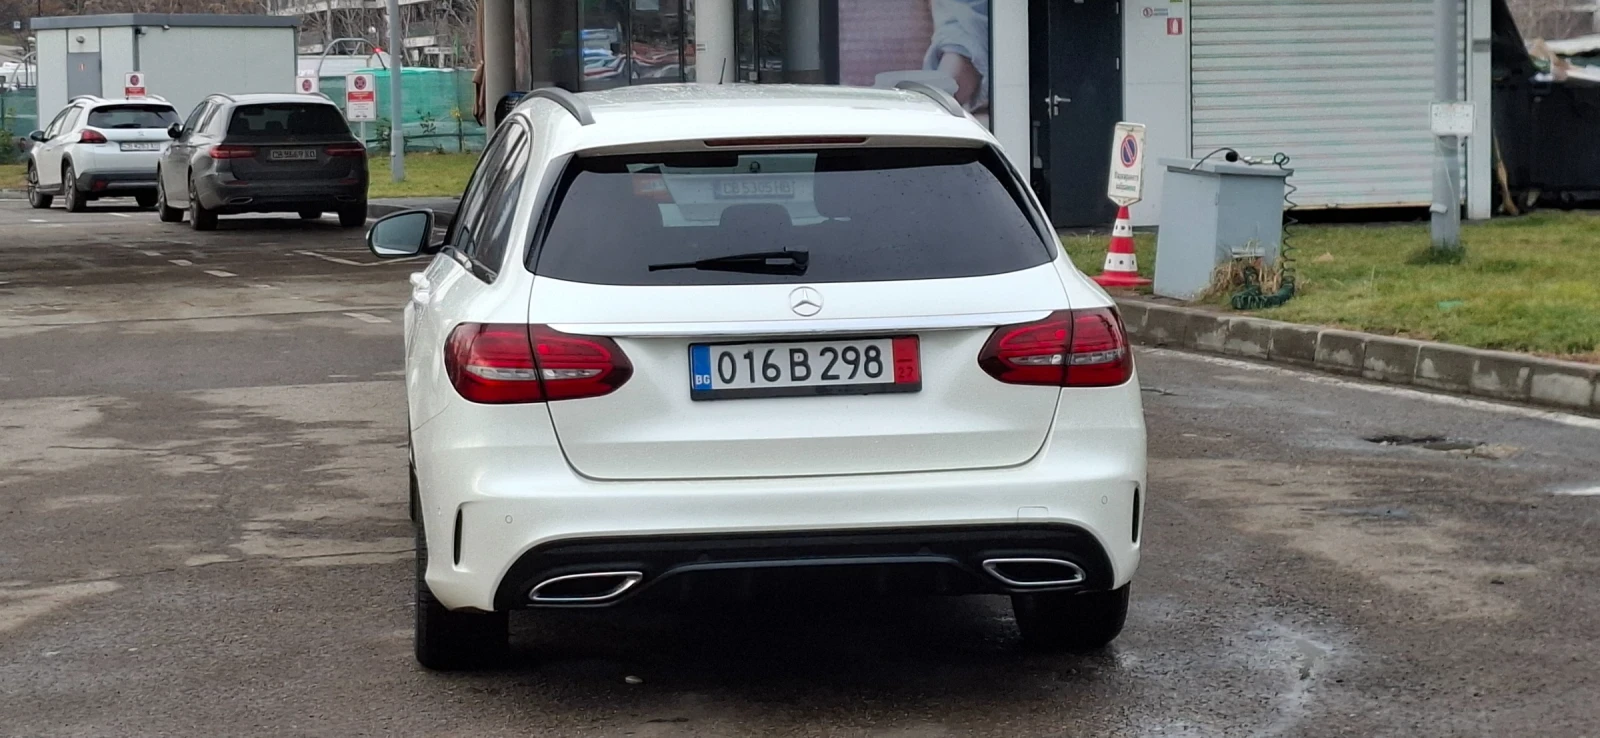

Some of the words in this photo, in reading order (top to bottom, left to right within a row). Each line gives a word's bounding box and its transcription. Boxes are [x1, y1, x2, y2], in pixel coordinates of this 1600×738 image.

[717, 350, 781, 384] 016
[819, 344, 884, 380] 298
[695, 374, 709, 385] BG
